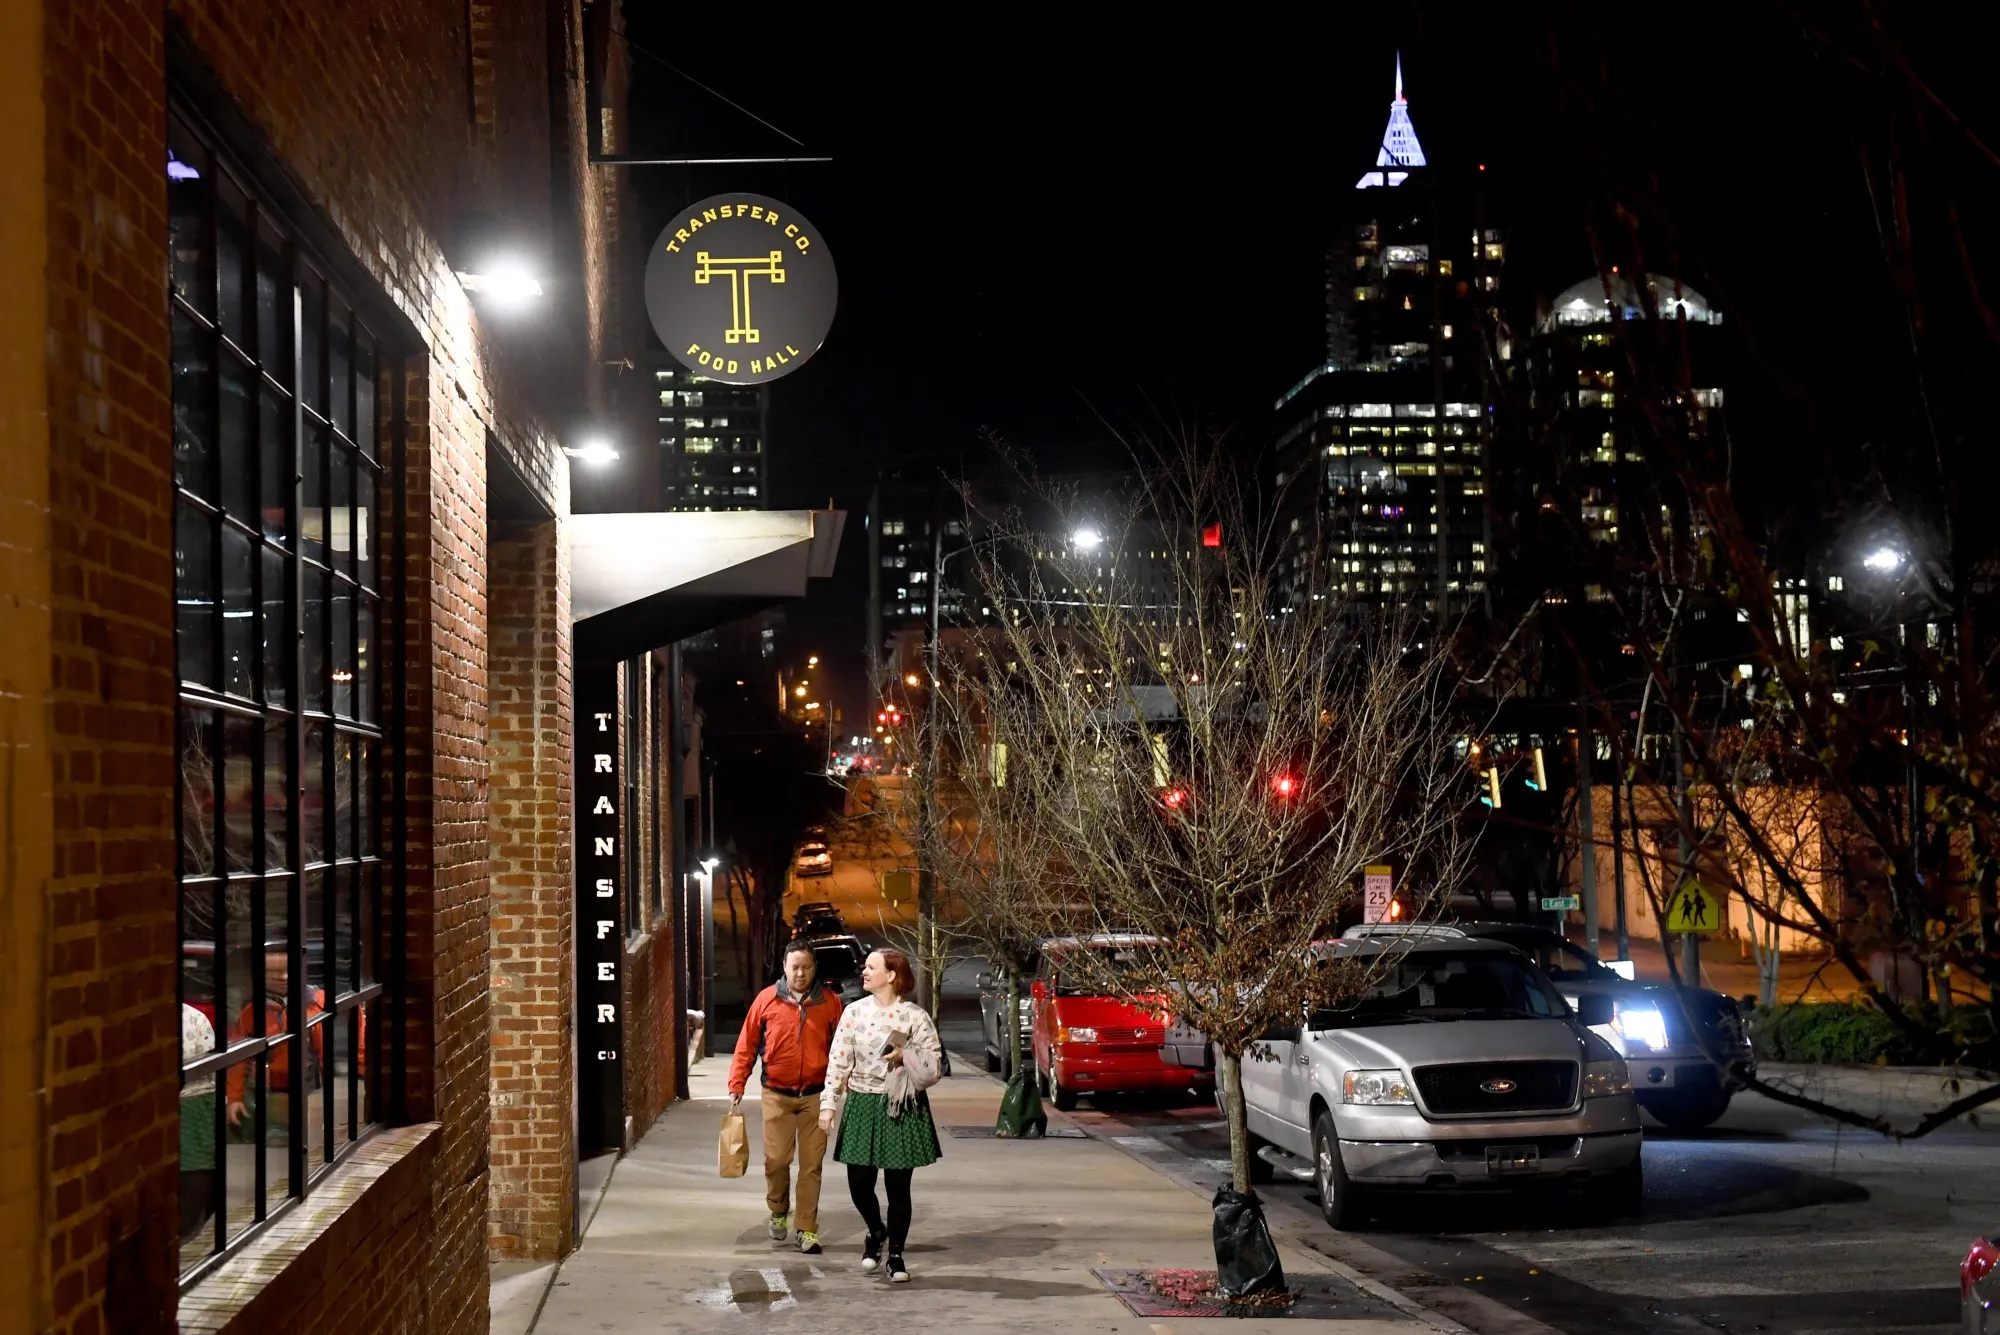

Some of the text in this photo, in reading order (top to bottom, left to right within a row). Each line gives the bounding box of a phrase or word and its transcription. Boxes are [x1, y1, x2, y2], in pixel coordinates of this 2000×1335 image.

[666, 204, 810, 255] TRANSFER CO.
[687, 344, 799, 374] FOOD HALL
[593, 713, 616, 1022] TRANSFER
[1370, 891, 1386, 905] 25
